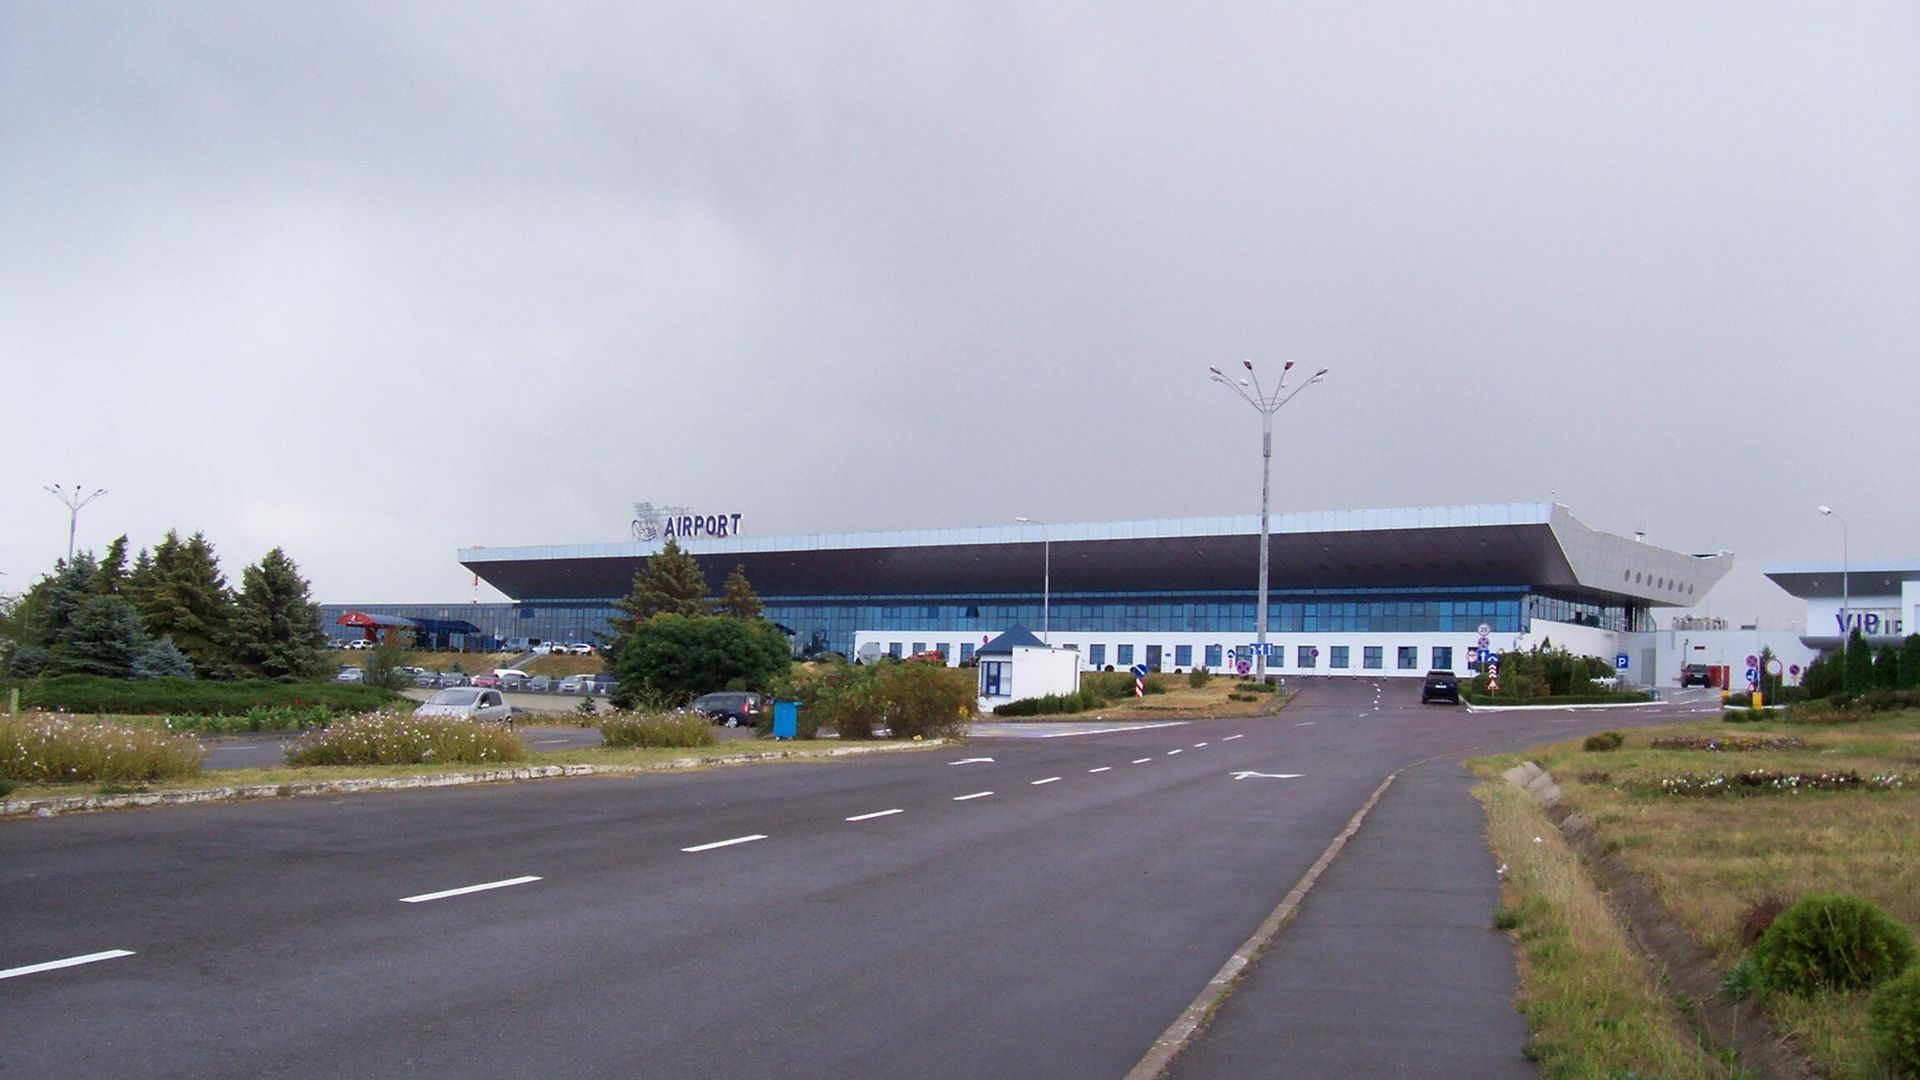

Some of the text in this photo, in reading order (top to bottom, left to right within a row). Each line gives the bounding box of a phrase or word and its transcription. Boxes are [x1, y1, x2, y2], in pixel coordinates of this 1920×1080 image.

[664, 514, 741, 537] AIRPORT
[1836, 613, 1879, 632] VIP
[1618, 657, 1626, 667] P
